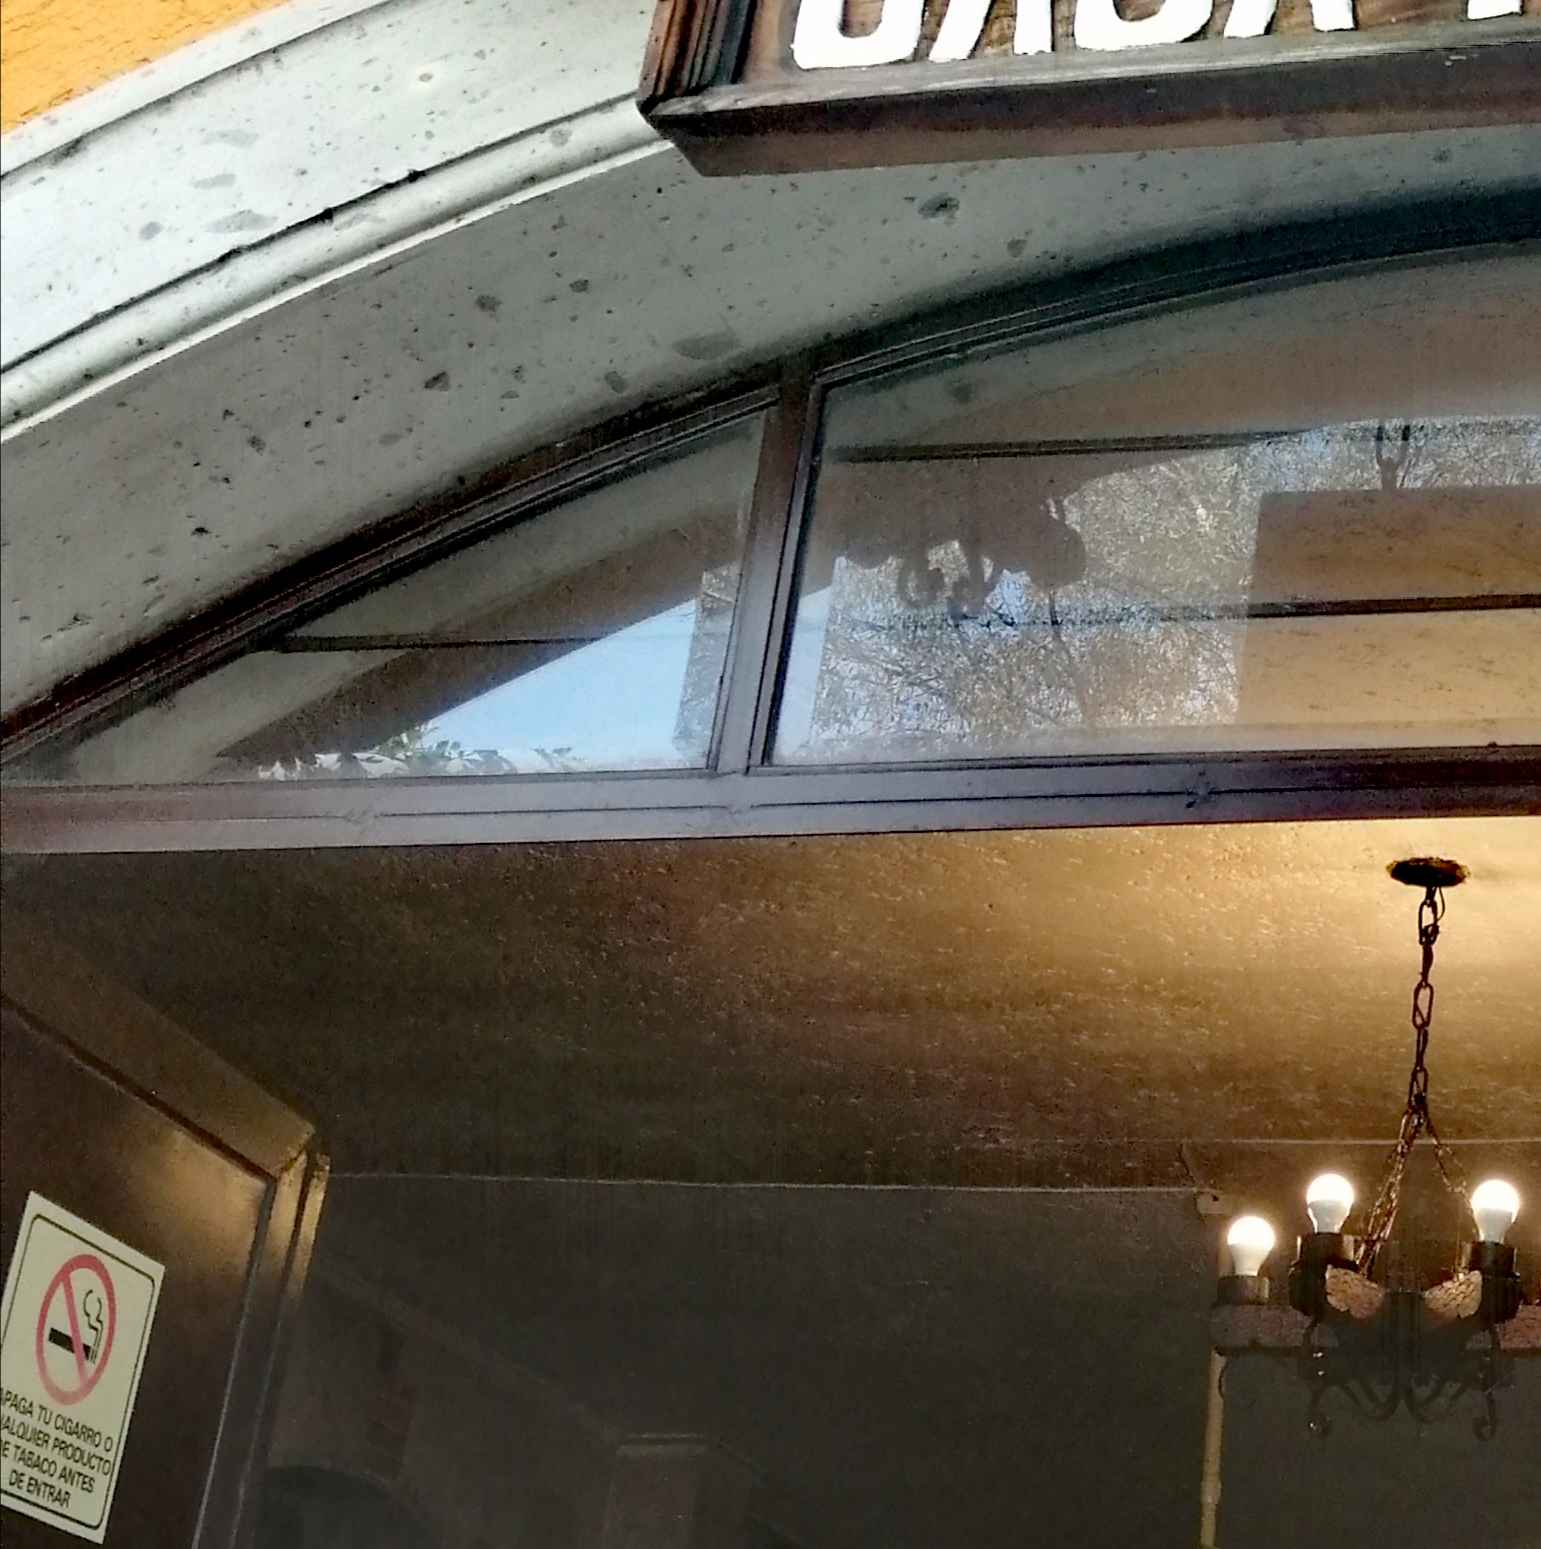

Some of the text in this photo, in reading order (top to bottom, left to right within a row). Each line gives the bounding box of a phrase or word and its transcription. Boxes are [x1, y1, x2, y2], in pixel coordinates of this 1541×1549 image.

[38, 1405, 53, 1425] TU
[54, 1414, 102, 1448] CIGARRO
[104, 1436, 113, 1452] O
[13, 1445, 57, 1477] TABACO
[58, 1465, 95, 1493] ANTES
[51, 1437, 111, 1476] PRODUCTO
[9, 1469, 71, 1508] DE ENTRAR
